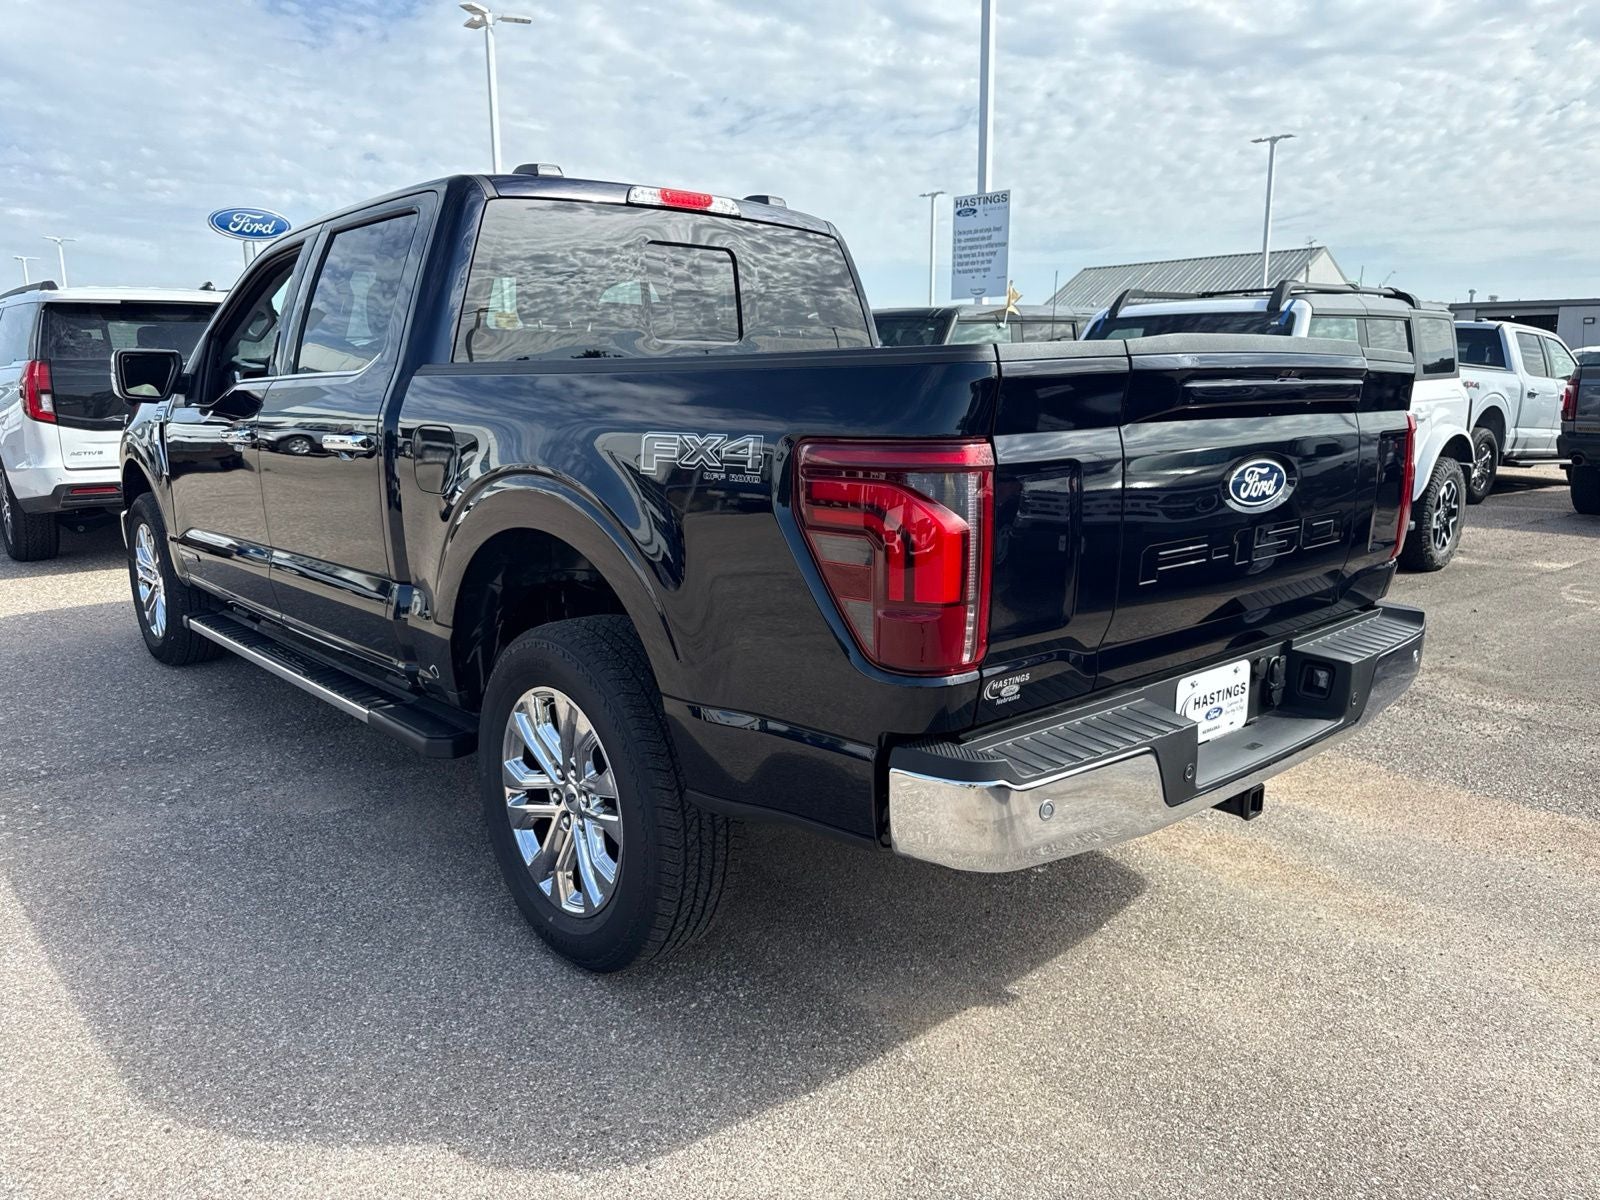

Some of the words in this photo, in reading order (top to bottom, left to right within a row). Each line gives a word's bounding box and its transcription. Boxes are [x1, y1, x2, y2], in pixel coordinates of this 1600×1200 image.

[955, 193, 1008, 208] HASTINGS
[228, 212, 276, 234] Ford
[640, 431, 764, 475] FX4
[703, 472, 726, 481] OFF
[729, 473, 761, 484] ROAD
[1239, 466, 1278, 499] Ford
[1138, 510, 1344, 586] F-150
[992, 673, 1030, 690] HASTINGS
[1194, 682, 1246, 710] HASTINGS
